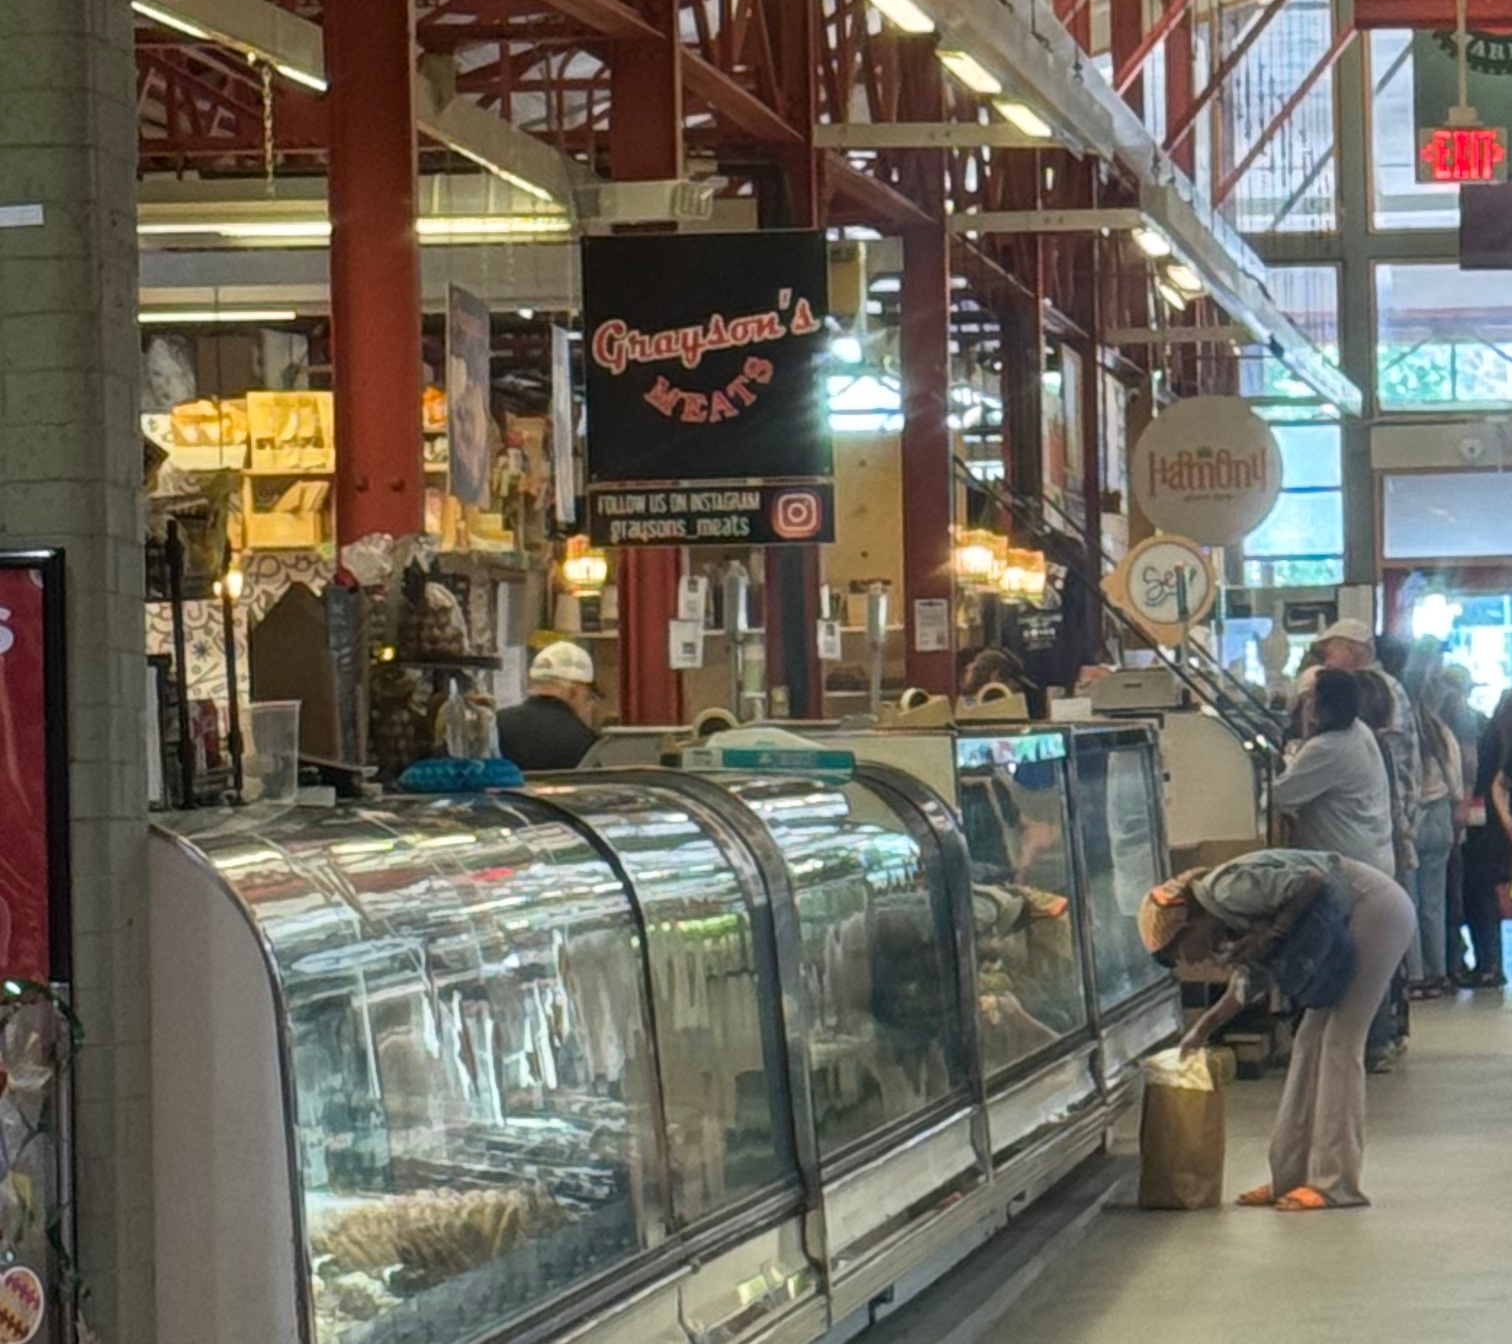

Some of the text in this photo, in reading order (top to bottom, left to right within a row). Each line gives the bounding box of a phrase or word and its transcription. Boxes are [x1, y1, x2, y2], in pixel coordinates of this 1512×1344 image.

[1432, 129, 1498, 180] EXIT
[592, 287, 821, 375] Grayson's
[643, 356, 775, 424] MEATS
[597, 493, 646, 516] FOLLOW
[649, 493, 668, 514] US
[669, 492, 689, 513] ON
